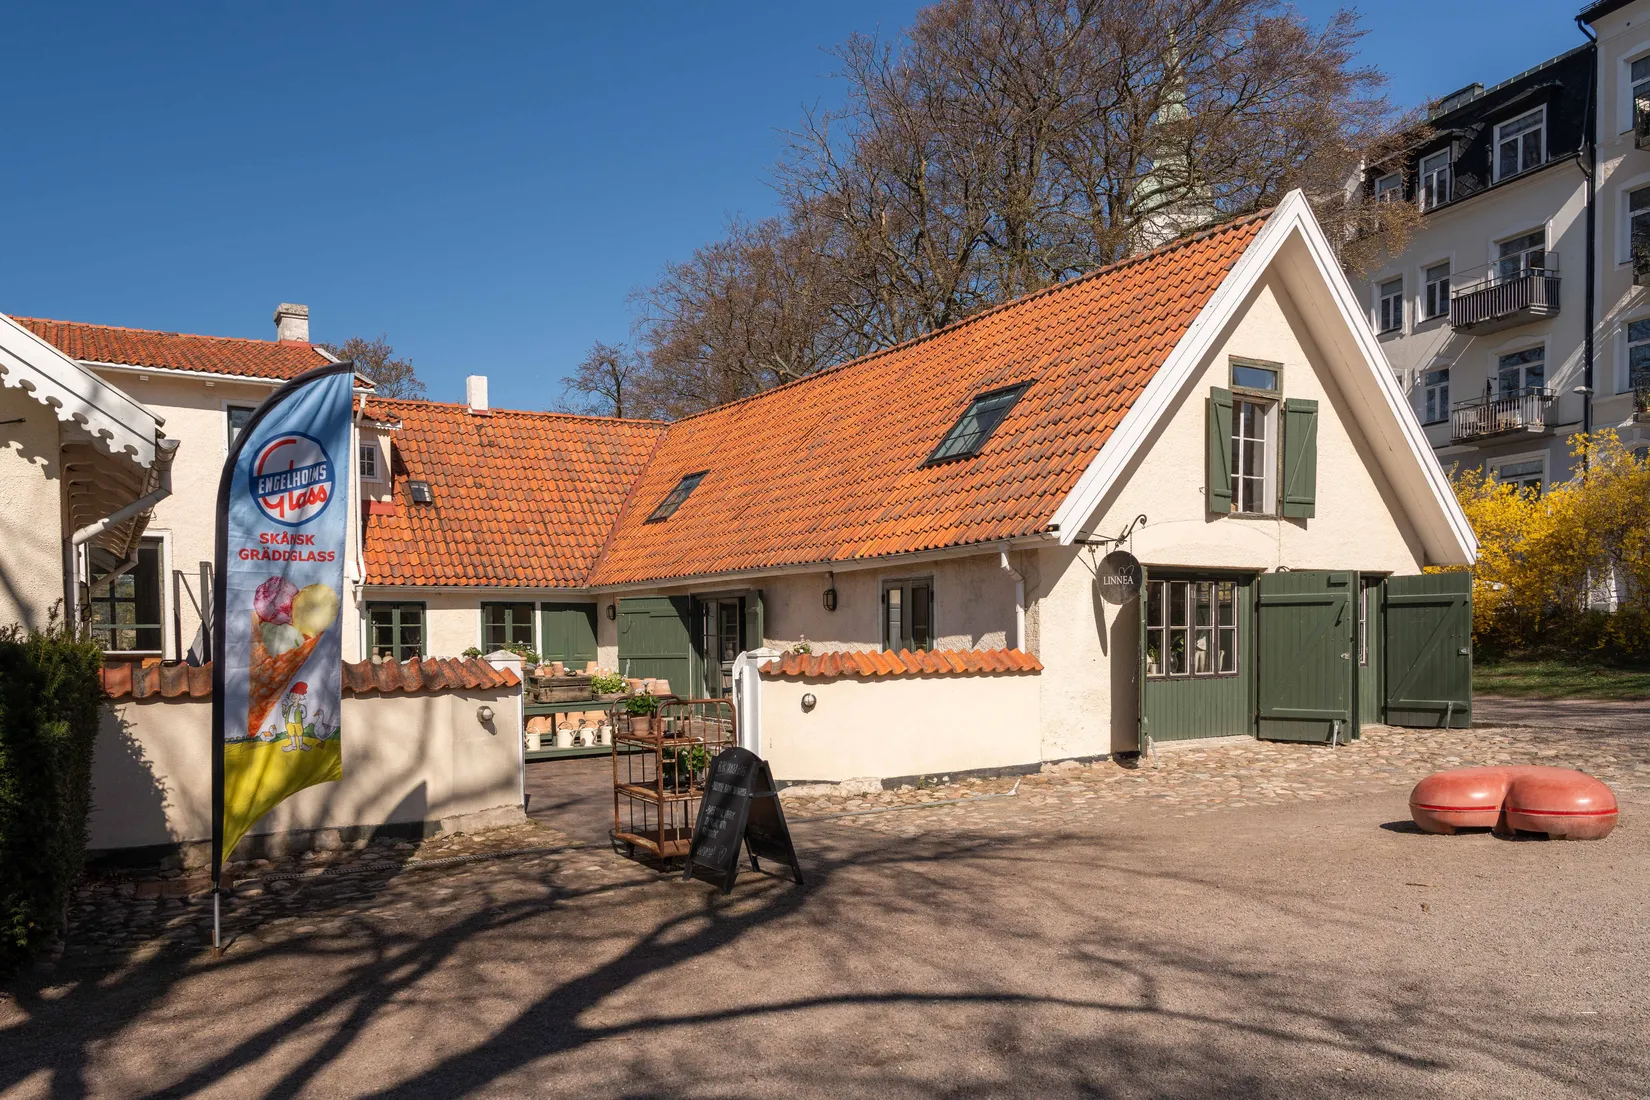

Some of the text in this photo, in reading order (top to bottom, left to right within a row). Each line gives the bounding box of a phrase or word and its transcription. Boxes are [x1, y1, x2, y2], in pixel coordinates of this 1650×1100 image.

[258, 464, 327, 494] ENGELHOLMS
[259, 531, 315, 546] SKÅNSK
[238, 547, 335, 562] GRÄDDGLASS
[1103, 575, 1134, 585] LINNEA
